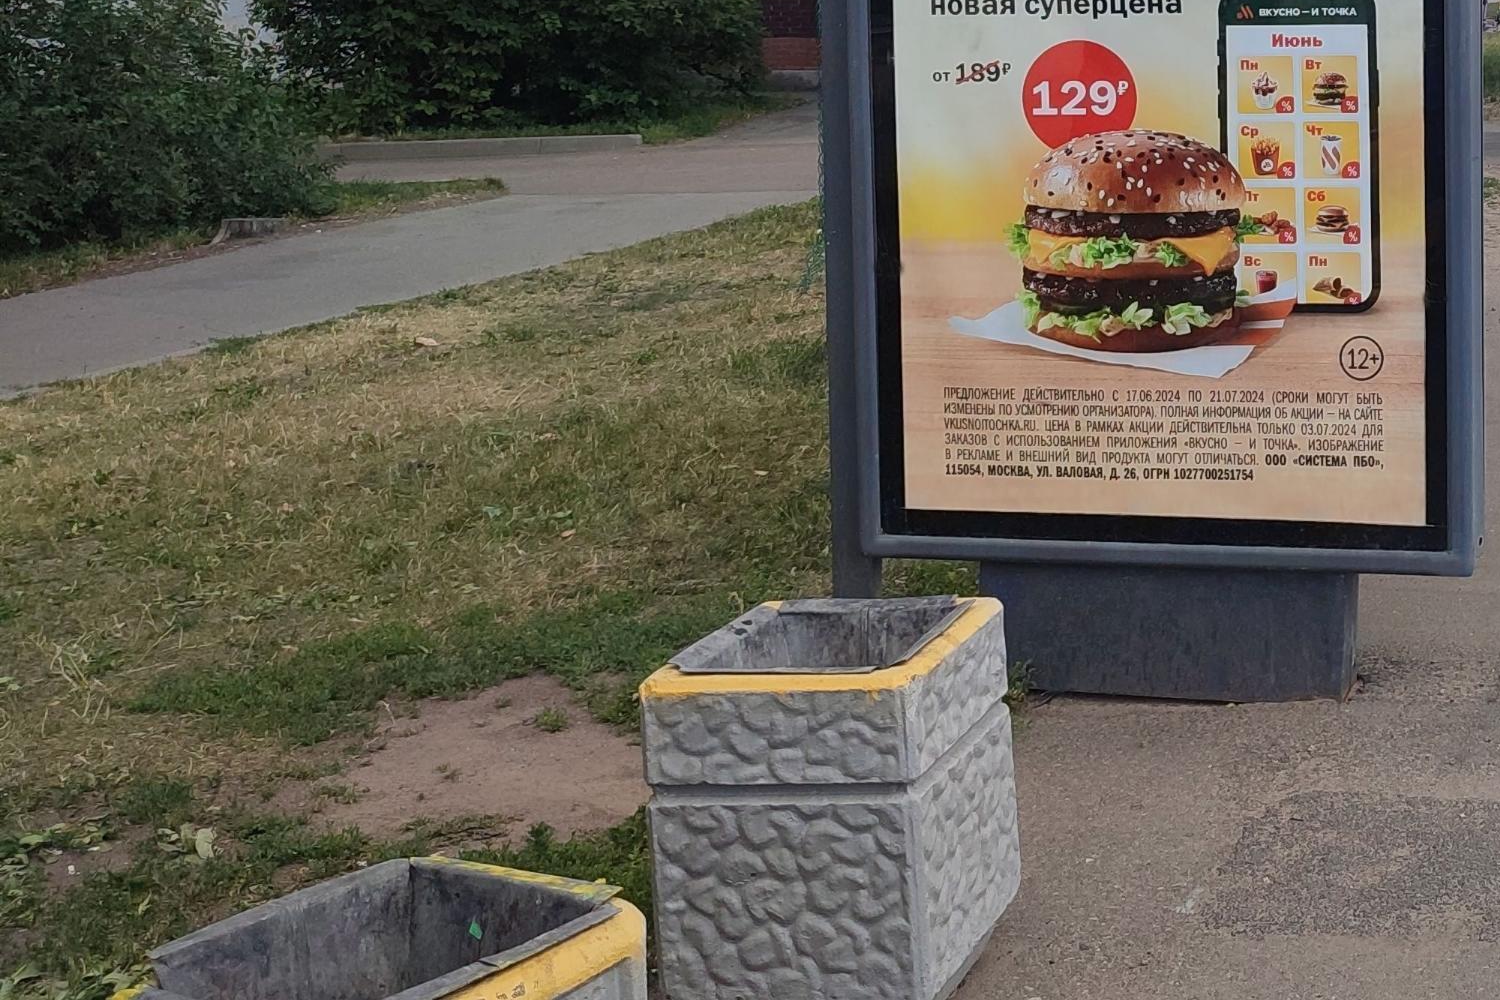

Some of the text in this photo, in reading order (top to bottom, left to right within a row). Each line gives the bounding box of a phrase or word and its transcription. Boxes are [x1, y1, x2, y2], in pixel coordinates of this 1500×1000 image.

[1258, 7, 1300, 16] ВКУСНО
[1311, 7, 1319, 16] И
[1322, 7, 1357, 16] ТОЧКА
[1271, 33, 1323, 47] Июнь
[1240, 59, 1322, 71] Пн Вт
[932, 71, 950, 82] от
[1240, 125, 1323, 138] Ср Чт
[1307, 190, 1325, 202] Сб
[1243, 256, 1328, 266] Вс Пн
[1347, 348, 1380, 370] 12+
[944, 386, 1383, 406] ПРЕДЛОЖЕНИЕ ДЕЙСТВИТЕЛЬНО С 17.06.2024 ПО 21.07.2024 (СРОКИ МОГУТ БЫТЬ
[944, 403, 996, 415] ИЗМЕНЕНЫ
[999, 404, 1012, 415] ПО
[1015, 404, 1079, 416] УСМОТРЕНИЮ
[1082, 405, 1157, 419] ОРГАНИЗАТОРА).
[1160, 406, 1199, 418] ПОЛНАЯ
[1202, 406, 1271, 420] ИНФОРМАЦИЯ
[1275, 407, 1287, 419] ОБ
[1291, 407, 1323, 421] АКЦИИ
[1338, 408, 1351, 420] НА
[1354, 406, 1383, 421] САЙТЕ
[944, 418, 1383, 438] VKUSNOITOCHKA.RU. ЦЕНА В РАМКАХ АКЦИИ ДЕЙСТВИТЕЛЬНА ТОЛЬКО 03.07.2024 ДЛЯ
[945, 433, 987, 445] ЗАКАЗОВ
[994, 434, 1000, 446] С
[1006, 435, 1100, 447] ИСПОЛЬЗОВАНИЕМ
[1107, 436, 1178, 448] ПРИЛОЖЕНИЯ
[1184, 437, 1228, 449] «ВКУСНО
[1249, 438, 1256, 449] И
[1263, 438, 1301, 451] ТОЧКА».
[1308, 439, 1384, 451] ИЗОБРАЖЕНИЕ
[945, 448, 1384, 470] В РЕКЛАМЕ И ВНЕШНИЙ ВИД ПРОДУКТА МОГУТ ОТЛИЧАТЬСЯ. ООО «СИСТЕМА ПБО»,
[945, 463, 1254, 480] 115054, МОСКВА, УЛ. ВАЛОВАЯ, Д. 26, ОГРН 1027700251754
